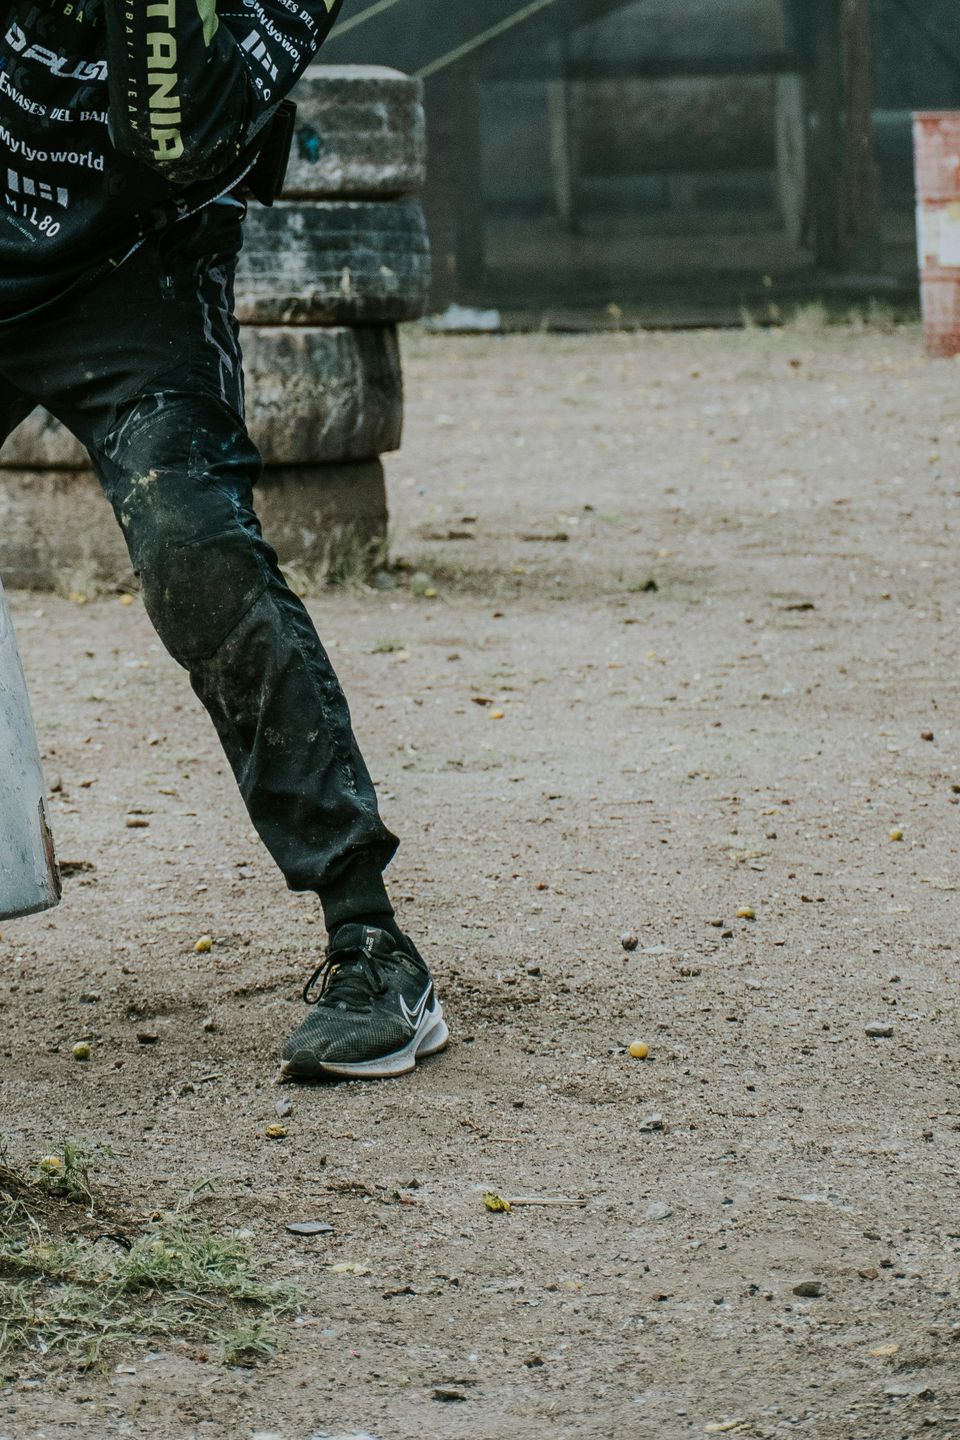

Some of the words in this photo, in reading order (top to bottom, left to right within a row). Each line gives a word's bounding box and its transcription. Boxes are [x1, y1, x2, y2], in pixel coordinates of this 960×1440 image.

[299, 10, 315, 31] DEL
[127, 77, 139, 130] TEAM
[49, 107, 74, 122] DEL
